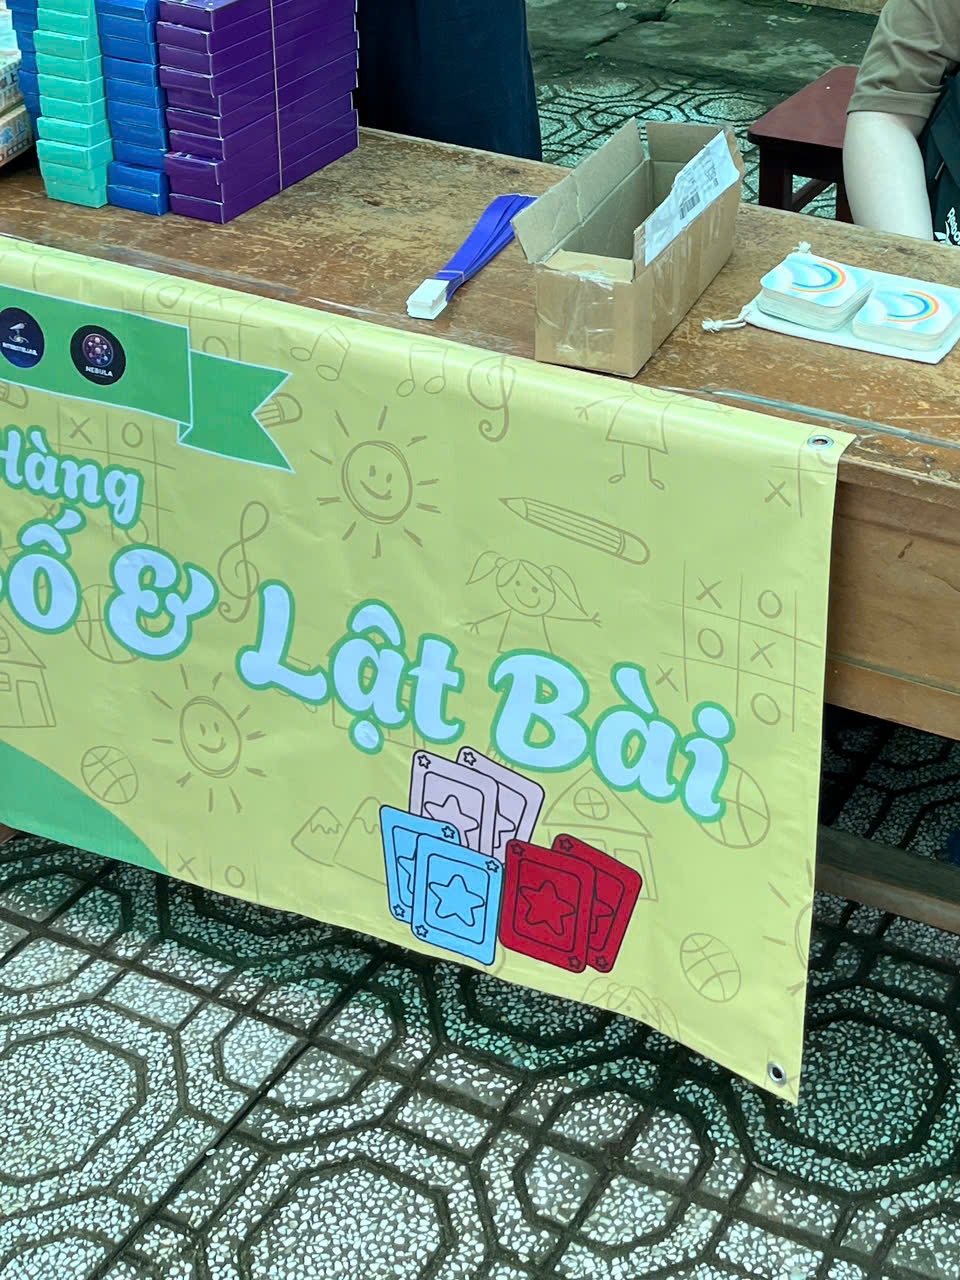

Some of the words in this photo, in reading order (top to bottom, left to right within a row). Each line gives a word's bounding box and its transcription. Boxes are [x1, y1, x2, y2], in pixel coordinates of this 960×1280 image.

[84, 365, 114, 378] NEBULA
[0, 507, 82, 631] ố
[108, 547, 215, 658] &
[239, 584, 462, 751] Lật
[492, 652, 732, 820] Bài
